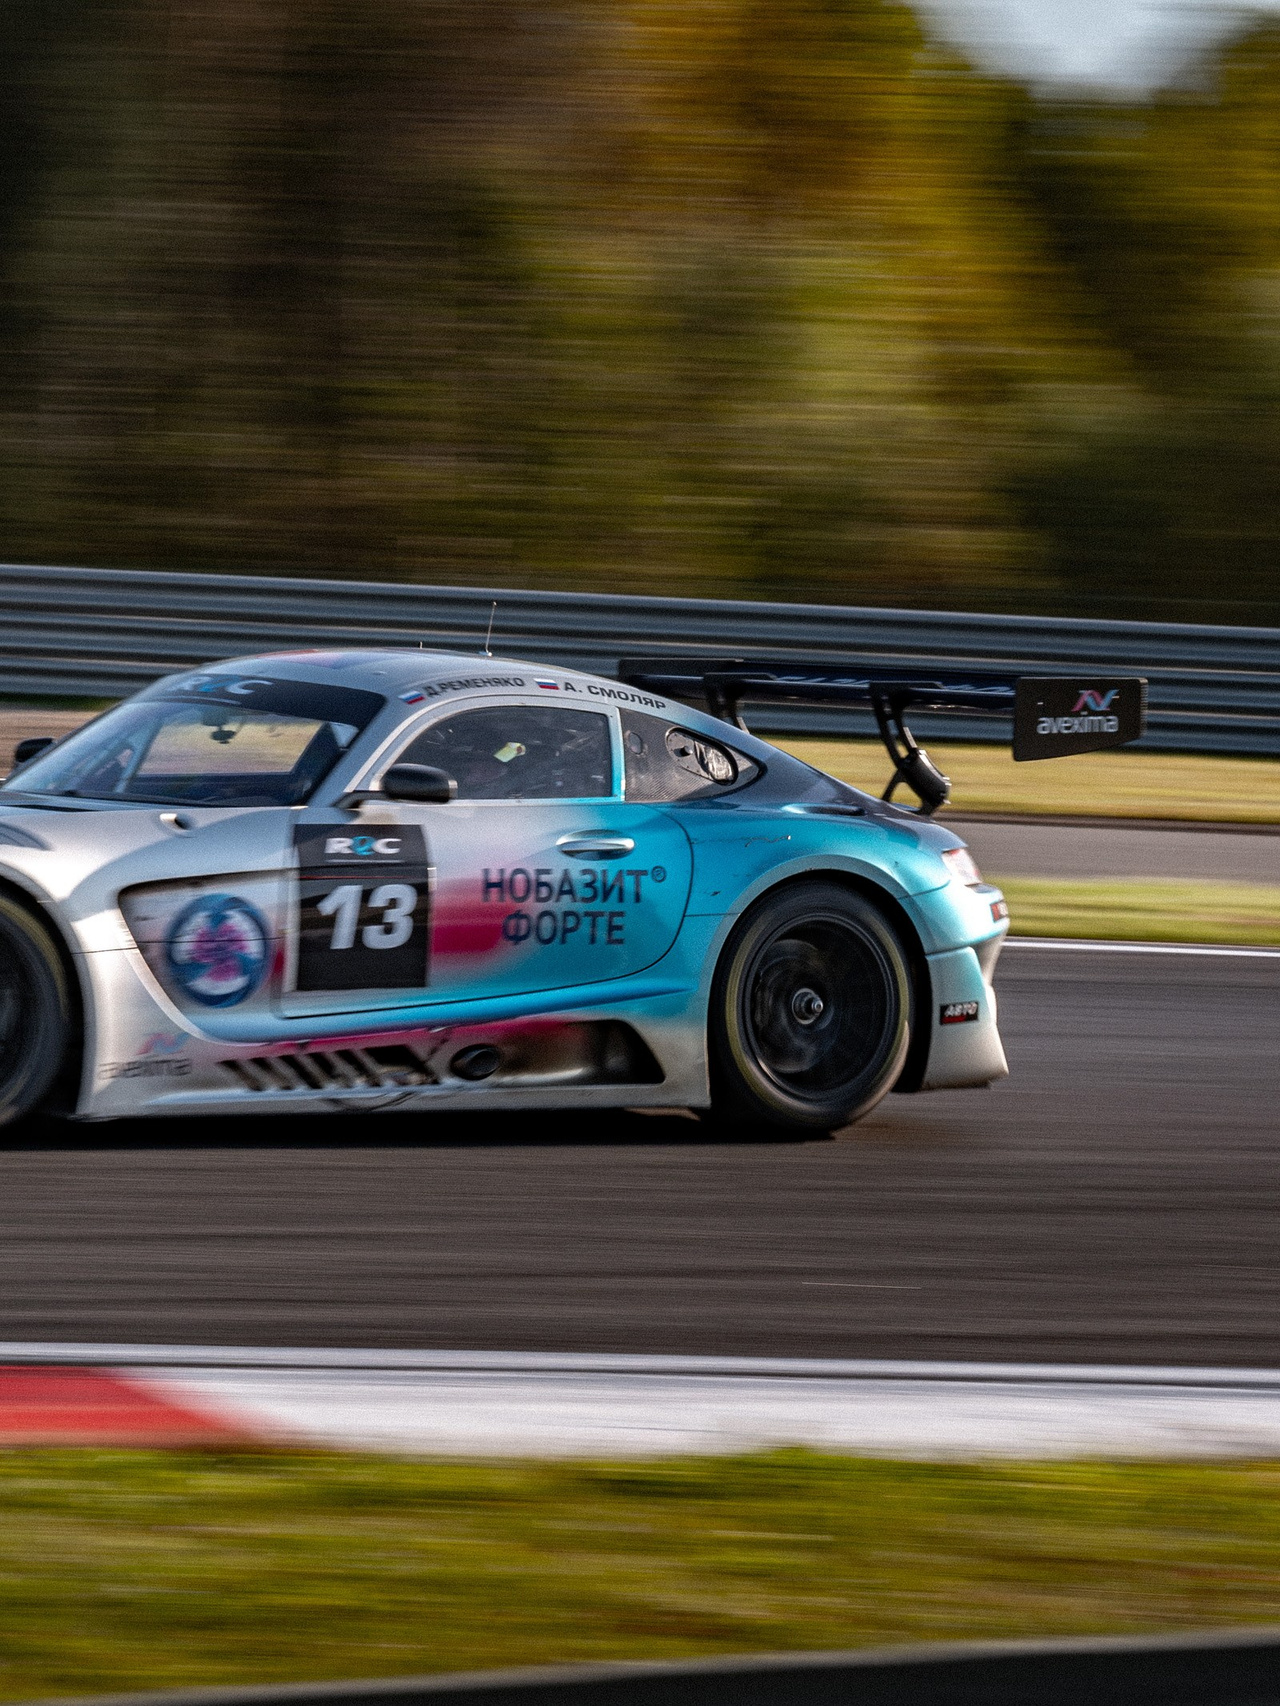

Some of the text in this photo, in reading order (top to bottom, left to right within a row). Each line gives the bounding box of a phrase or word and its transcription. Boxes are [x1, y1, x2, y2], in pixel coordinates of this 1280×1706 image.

[587, 685, 667, 709] СМОЛЯР
[1036, 712, 1119, 735] avexima
[316, 884, 418, 950] 13
[501, 909, 626, 946] ФОРТЕ
